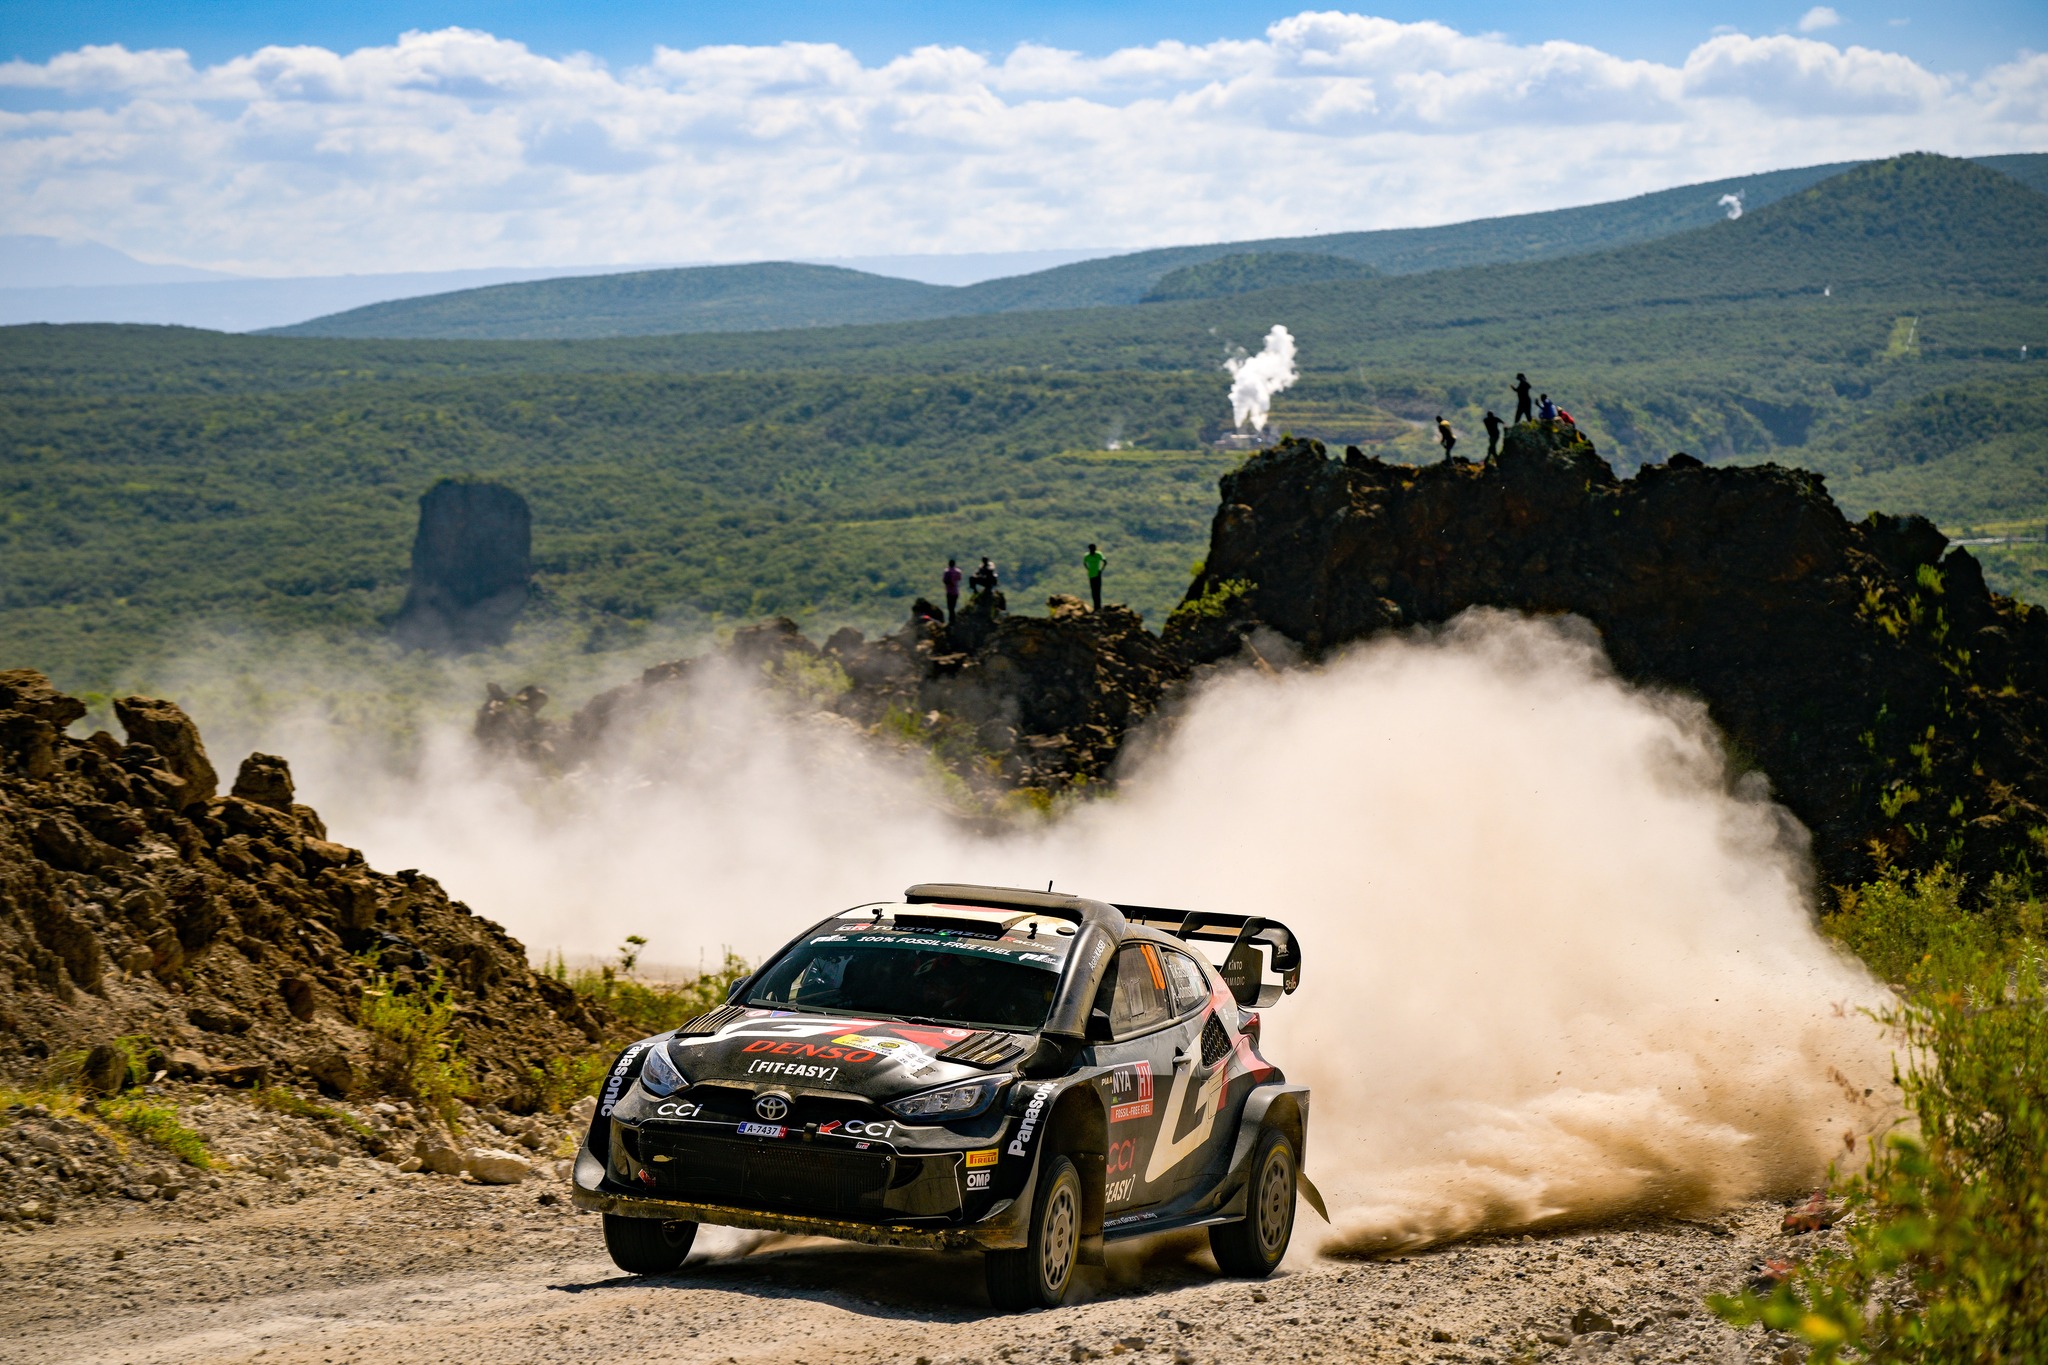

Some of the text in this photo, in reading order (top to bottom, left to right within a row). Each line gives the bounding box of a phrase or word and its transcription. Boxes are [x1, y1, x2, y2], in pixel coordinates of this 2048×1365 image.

[873, 925, 935, 933] TOYOTA
[1000, 936, 1056, 951] Racing
[896, 937, 981, 951] FOSSIL-FREE
[978, 946, 1012, 956] FUEL
[1140, 943, 1166, 990] 18
[742, 1040, 876, 1063] DENSO
[1112, 1070, 1132, 1094] NYA
[1140, 1104, 1150, 1114] FUEL
[747, 1124, 778, 1135] A-7437
[969, 1151, 998, 1165] PIRELLI
[967, 1174, 991, 1187] OMP
